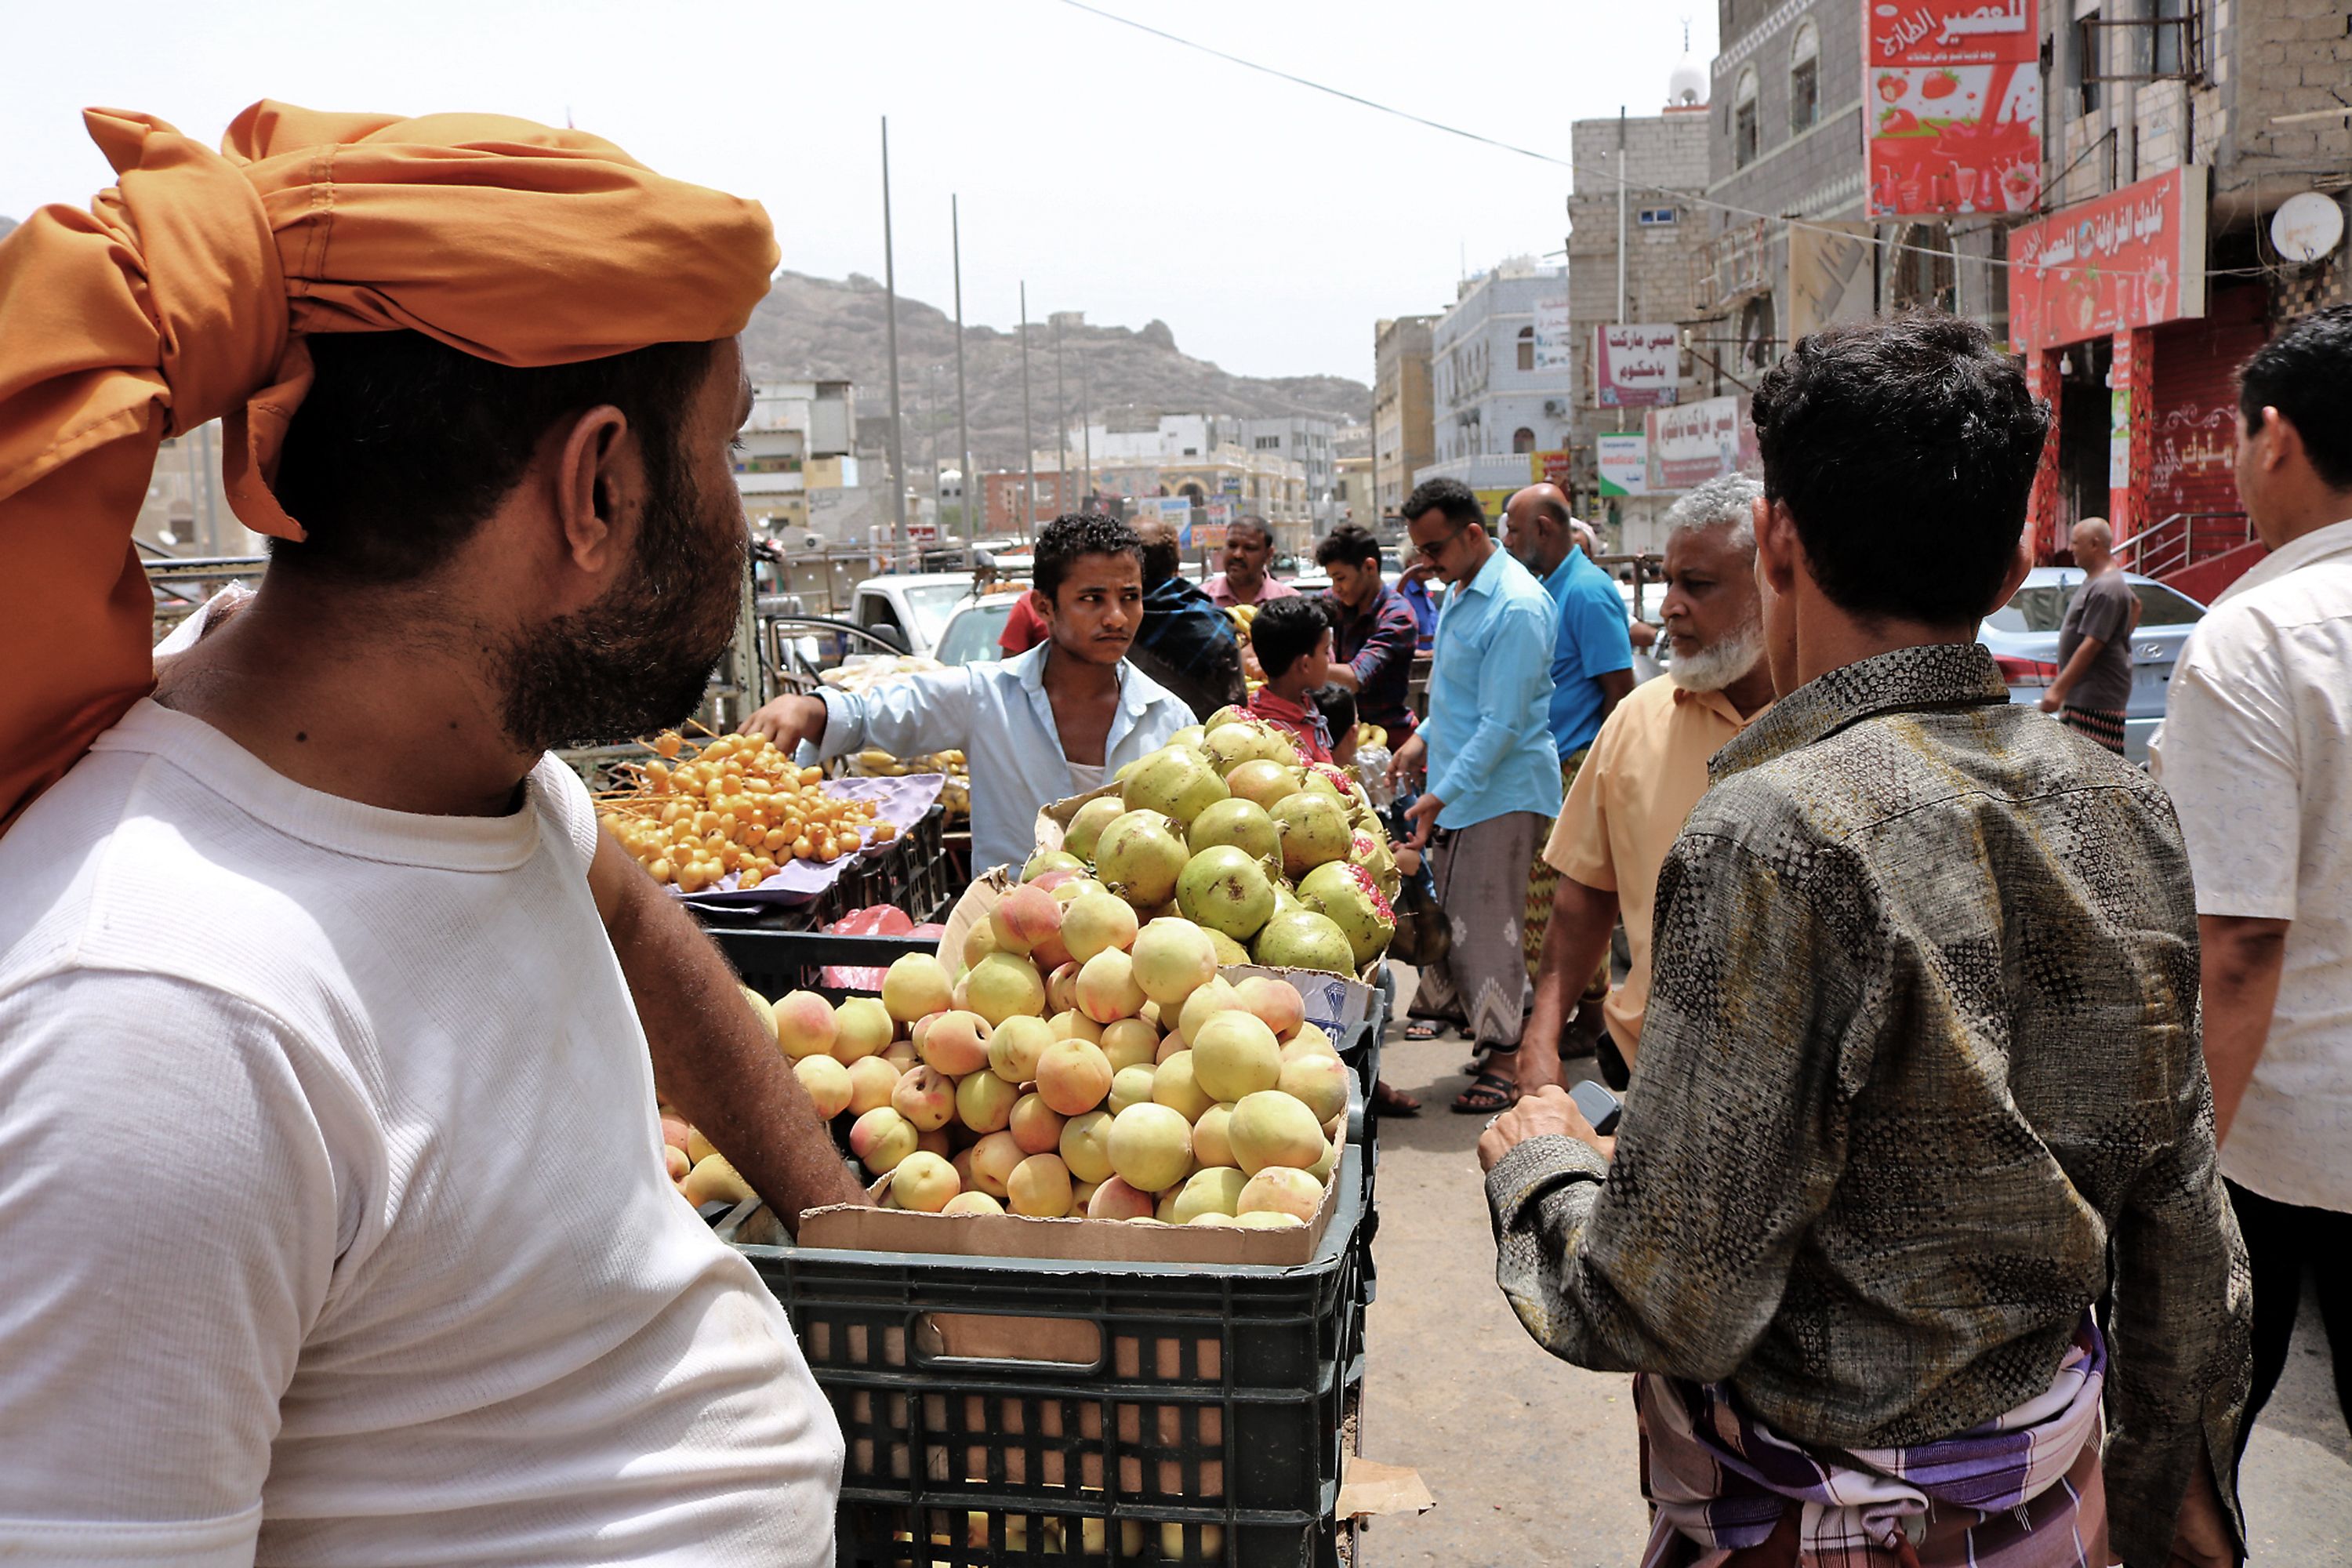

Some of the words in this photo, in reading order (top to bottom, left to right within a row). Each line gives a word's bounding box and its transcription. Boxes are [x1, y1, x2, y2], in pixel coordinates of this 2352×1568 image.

[1876, 7, 1937, 57] الطازج
[1936, 0, 2027, 45] للعصير
[1610, 330, 1644, 351] ماركت
[1647, 330, 1674, 354] ميني
